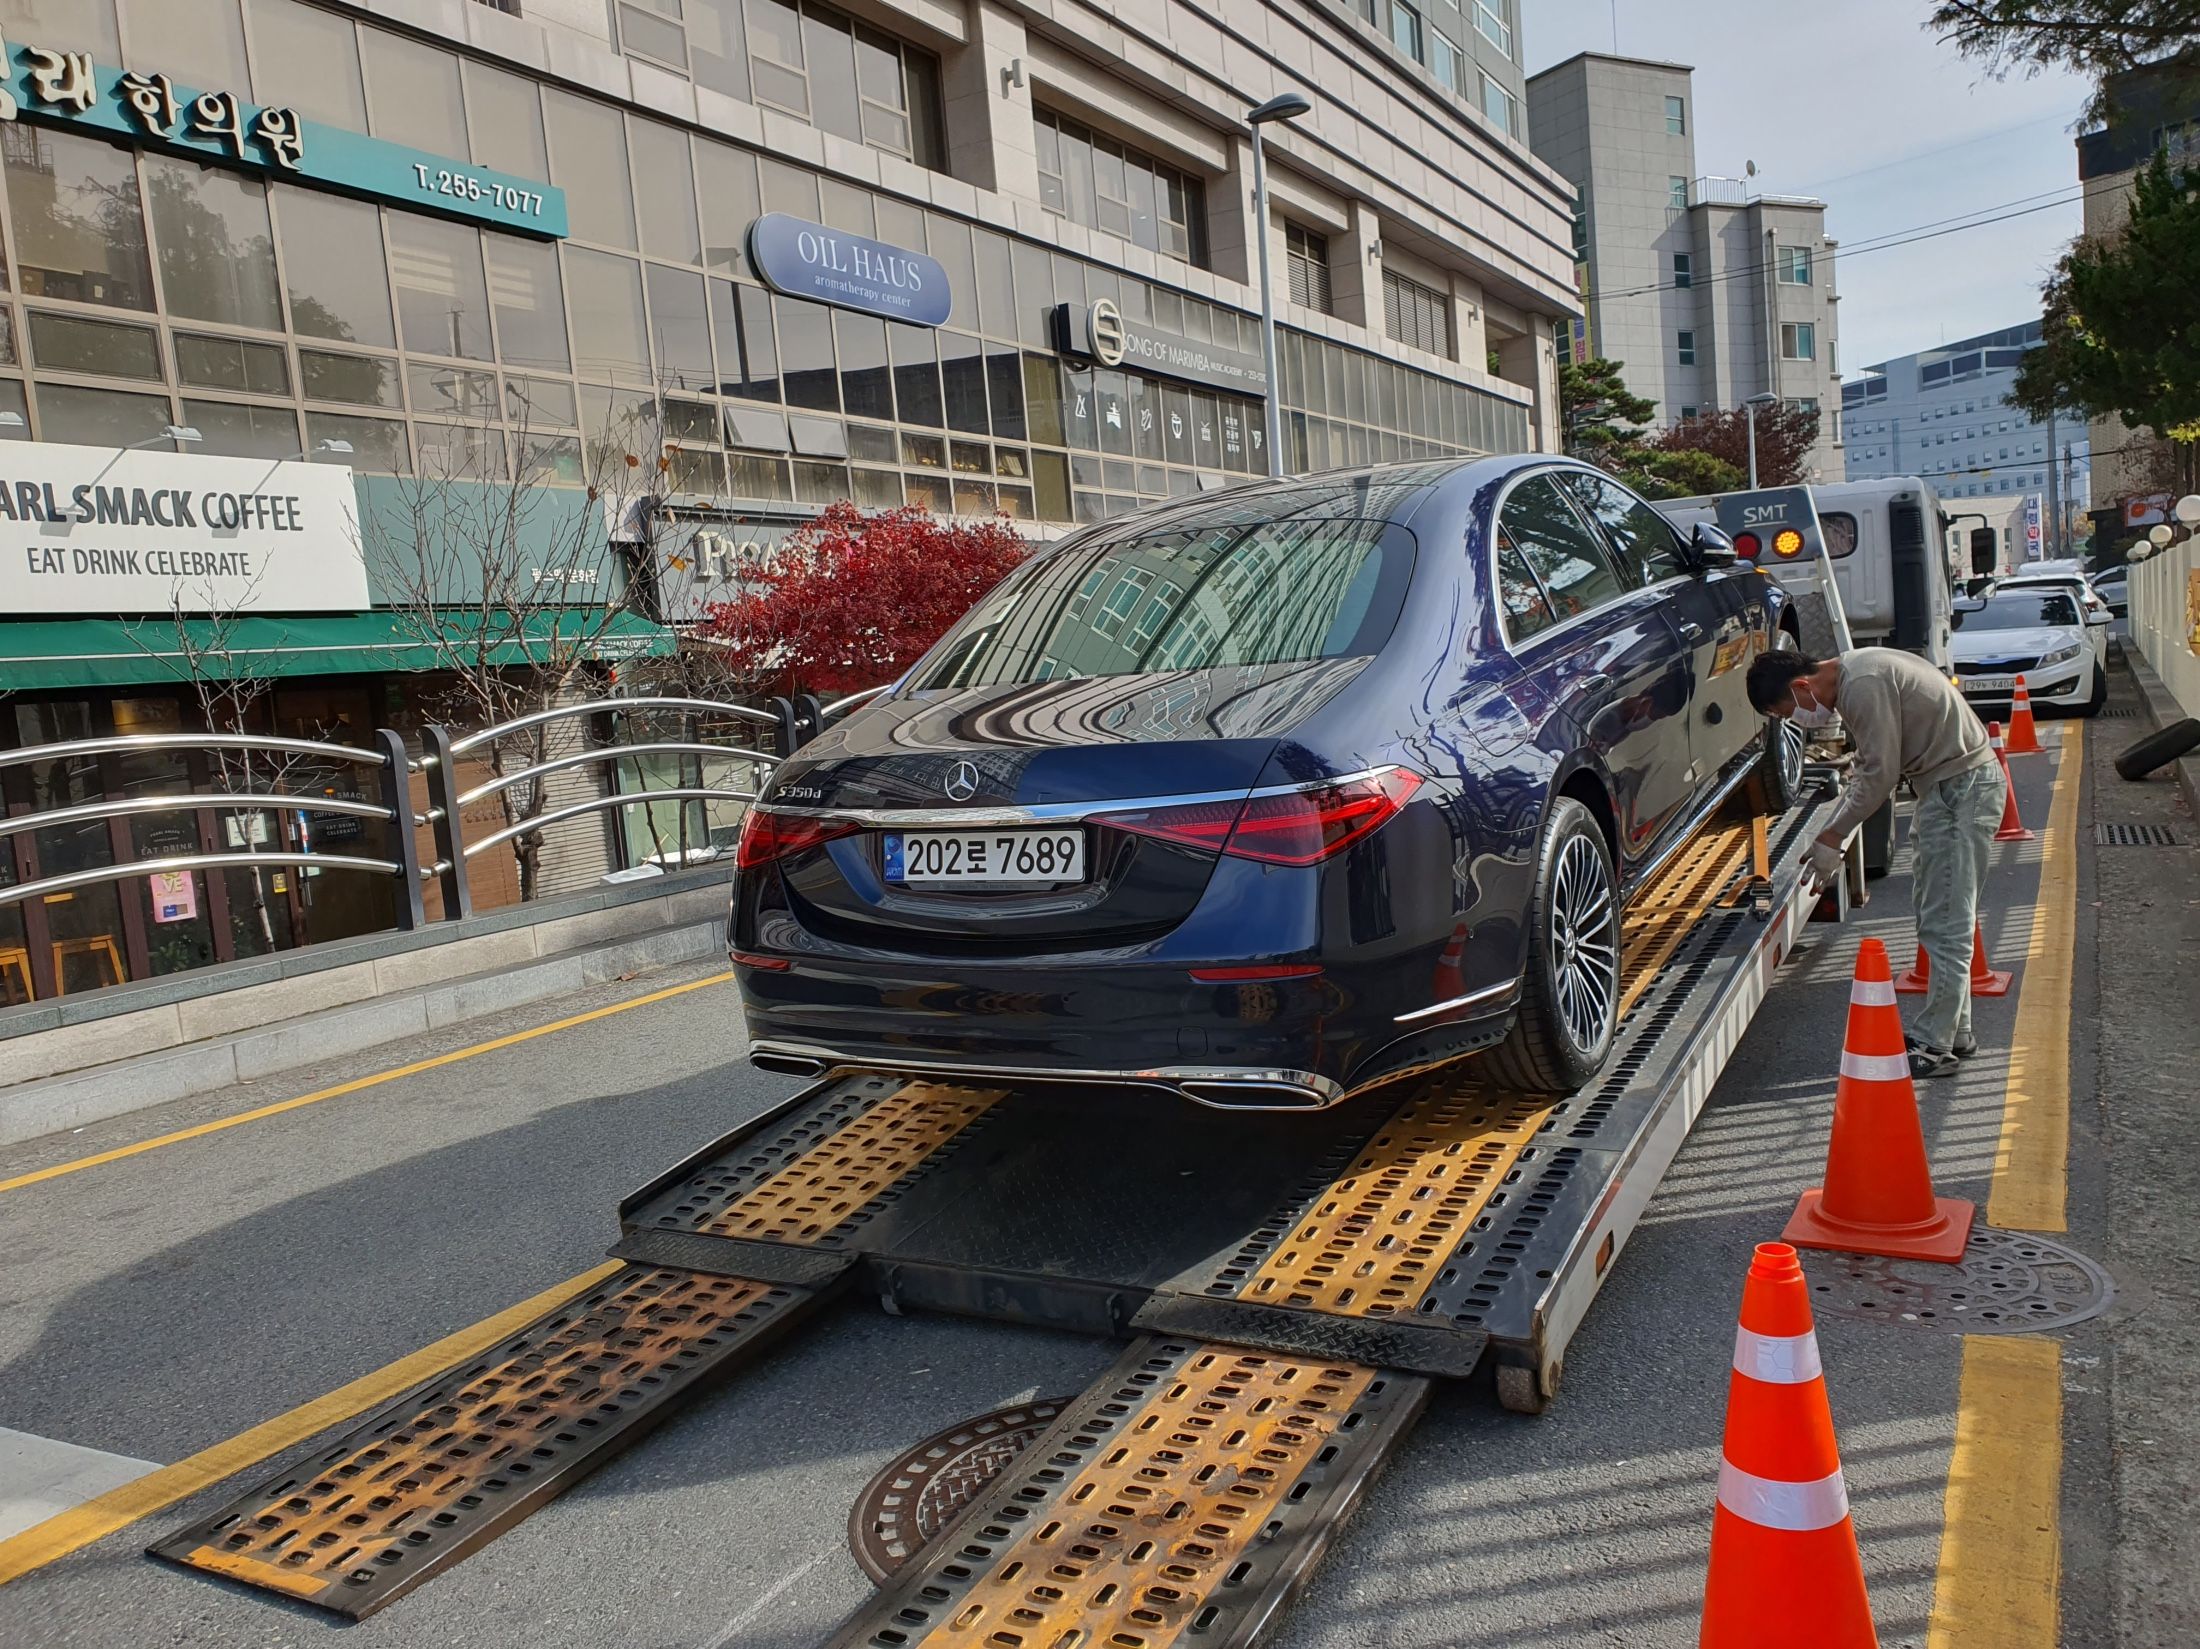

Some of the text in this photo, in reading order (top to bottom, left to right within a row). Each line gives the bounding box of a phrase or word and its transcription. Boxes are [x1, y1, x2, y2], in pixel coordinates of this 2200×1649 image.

[414, 162, 543, 216] T.255-7077
[797, 231, 922, 292] OIL HAUS
[814, 274, 912, 308] aromatherapy center
[1153, 342, 1167, 361] OF
[1168, 345, 1211, 373] MARIMBA
[72, 484, 198, 528] SMACK
[202, 492, 304, 532] COFFEE
[1743, 503, 1789, 524] SMT
[27, 547, 252, 577] EAT DRINK CELEBRATE
[907, 836, 1076, 875] 202로 7689
